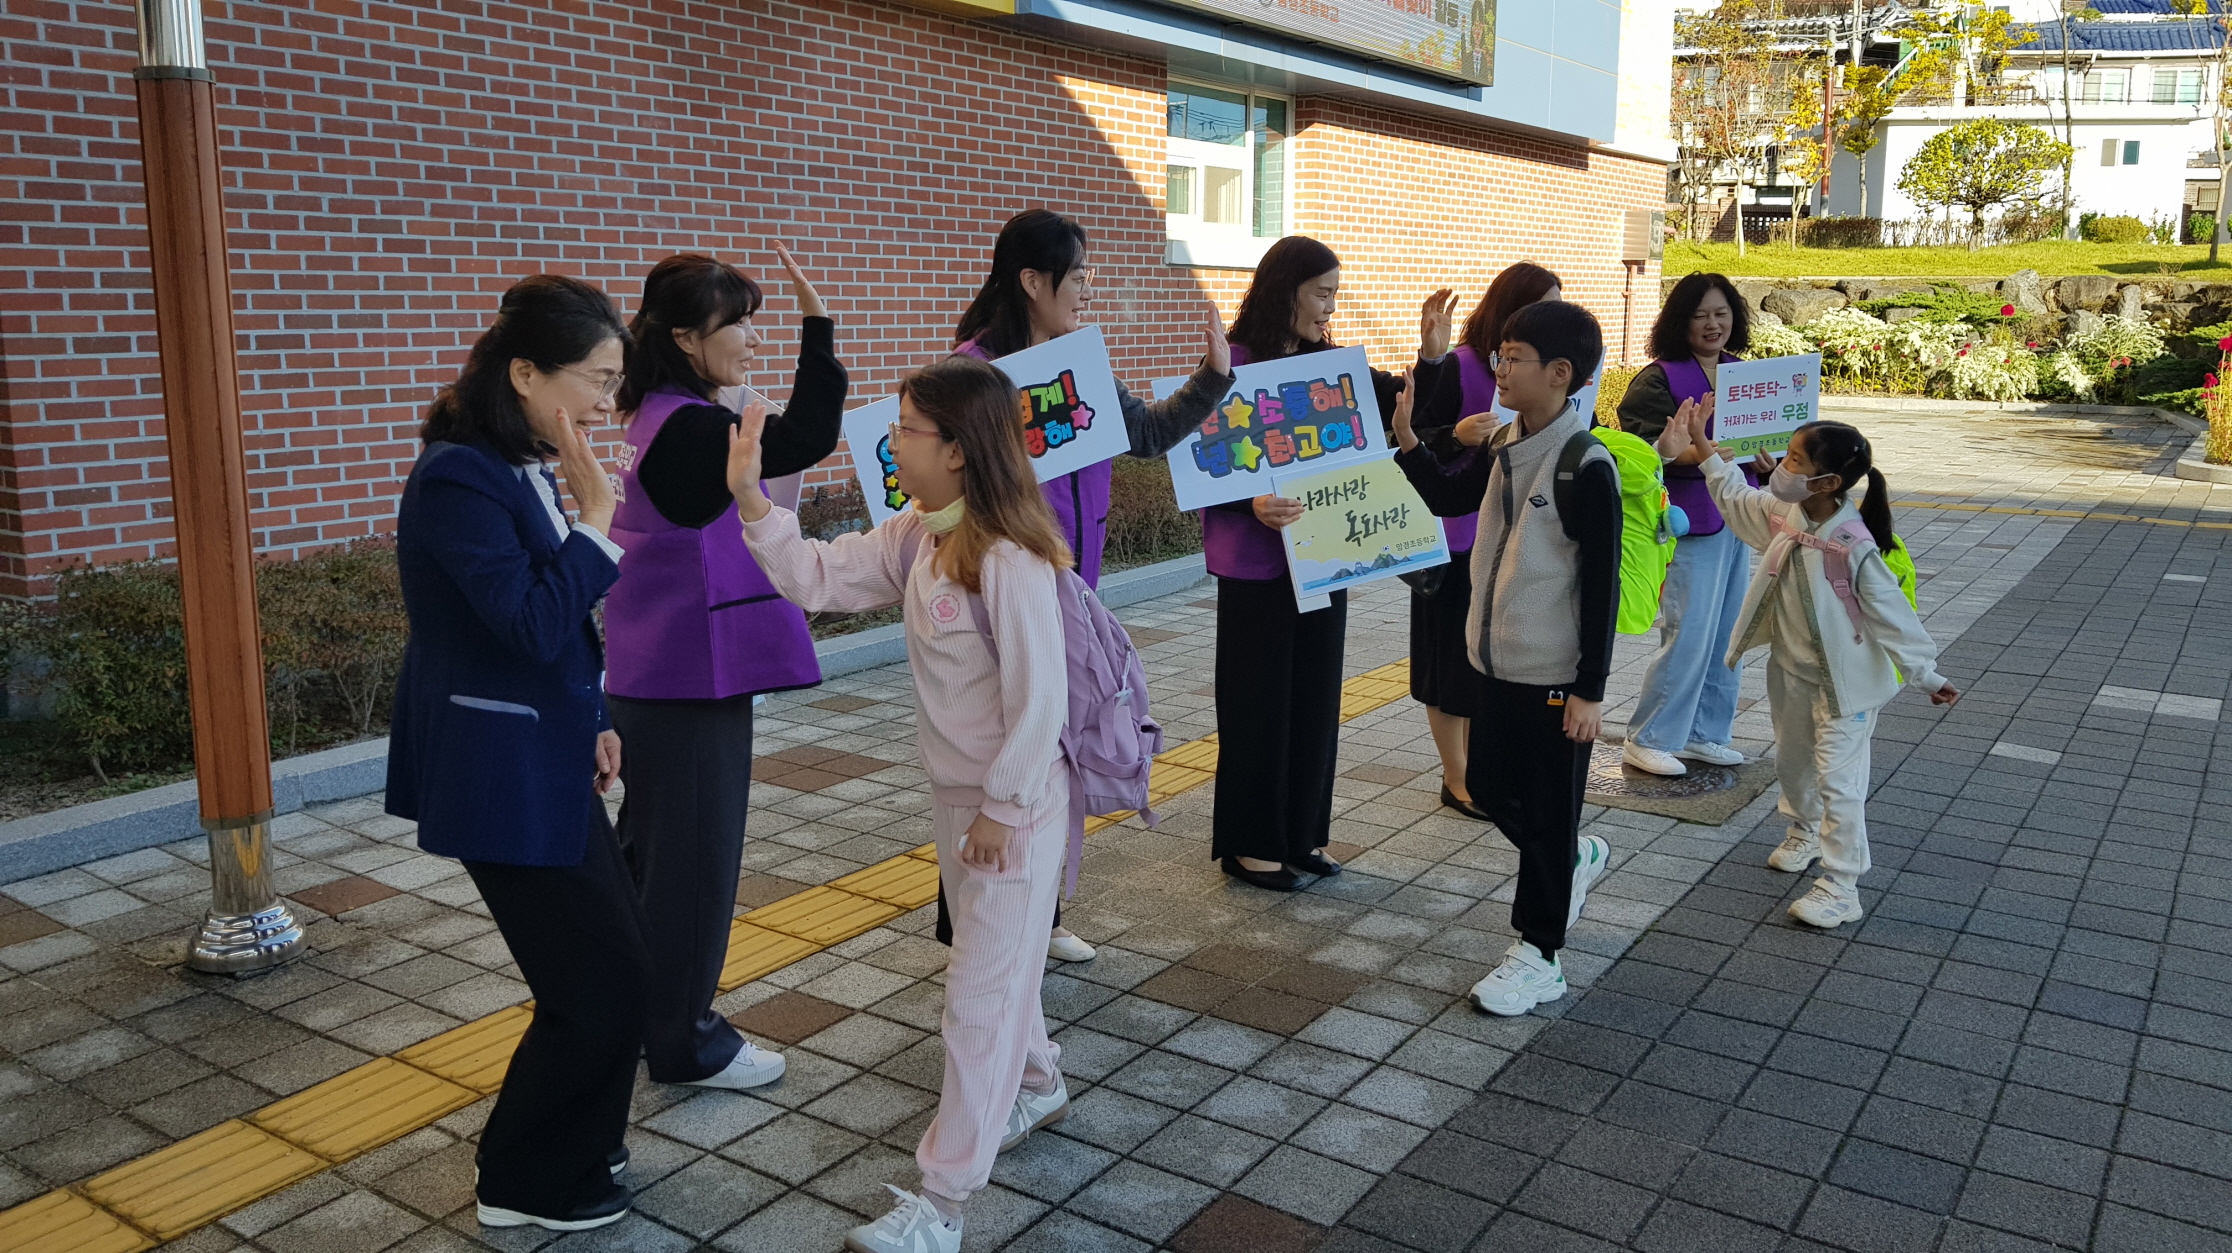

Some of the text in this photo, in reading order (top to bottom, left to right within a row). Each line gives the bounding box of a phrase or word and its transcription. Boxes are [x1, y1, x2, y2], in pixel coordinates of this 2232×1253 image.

[1257, 376, 1355, 425] 소중해!
[1723, 402, 1809, 428] 커져가는 우리 우정
[1195, 440, 1229, 475] 넌
[1263, 414, 1365, 465] 최고야!
[1297, 474, 1371, 511] 나라사랑
[1345, 503, 1411, 547] 독도사랑
